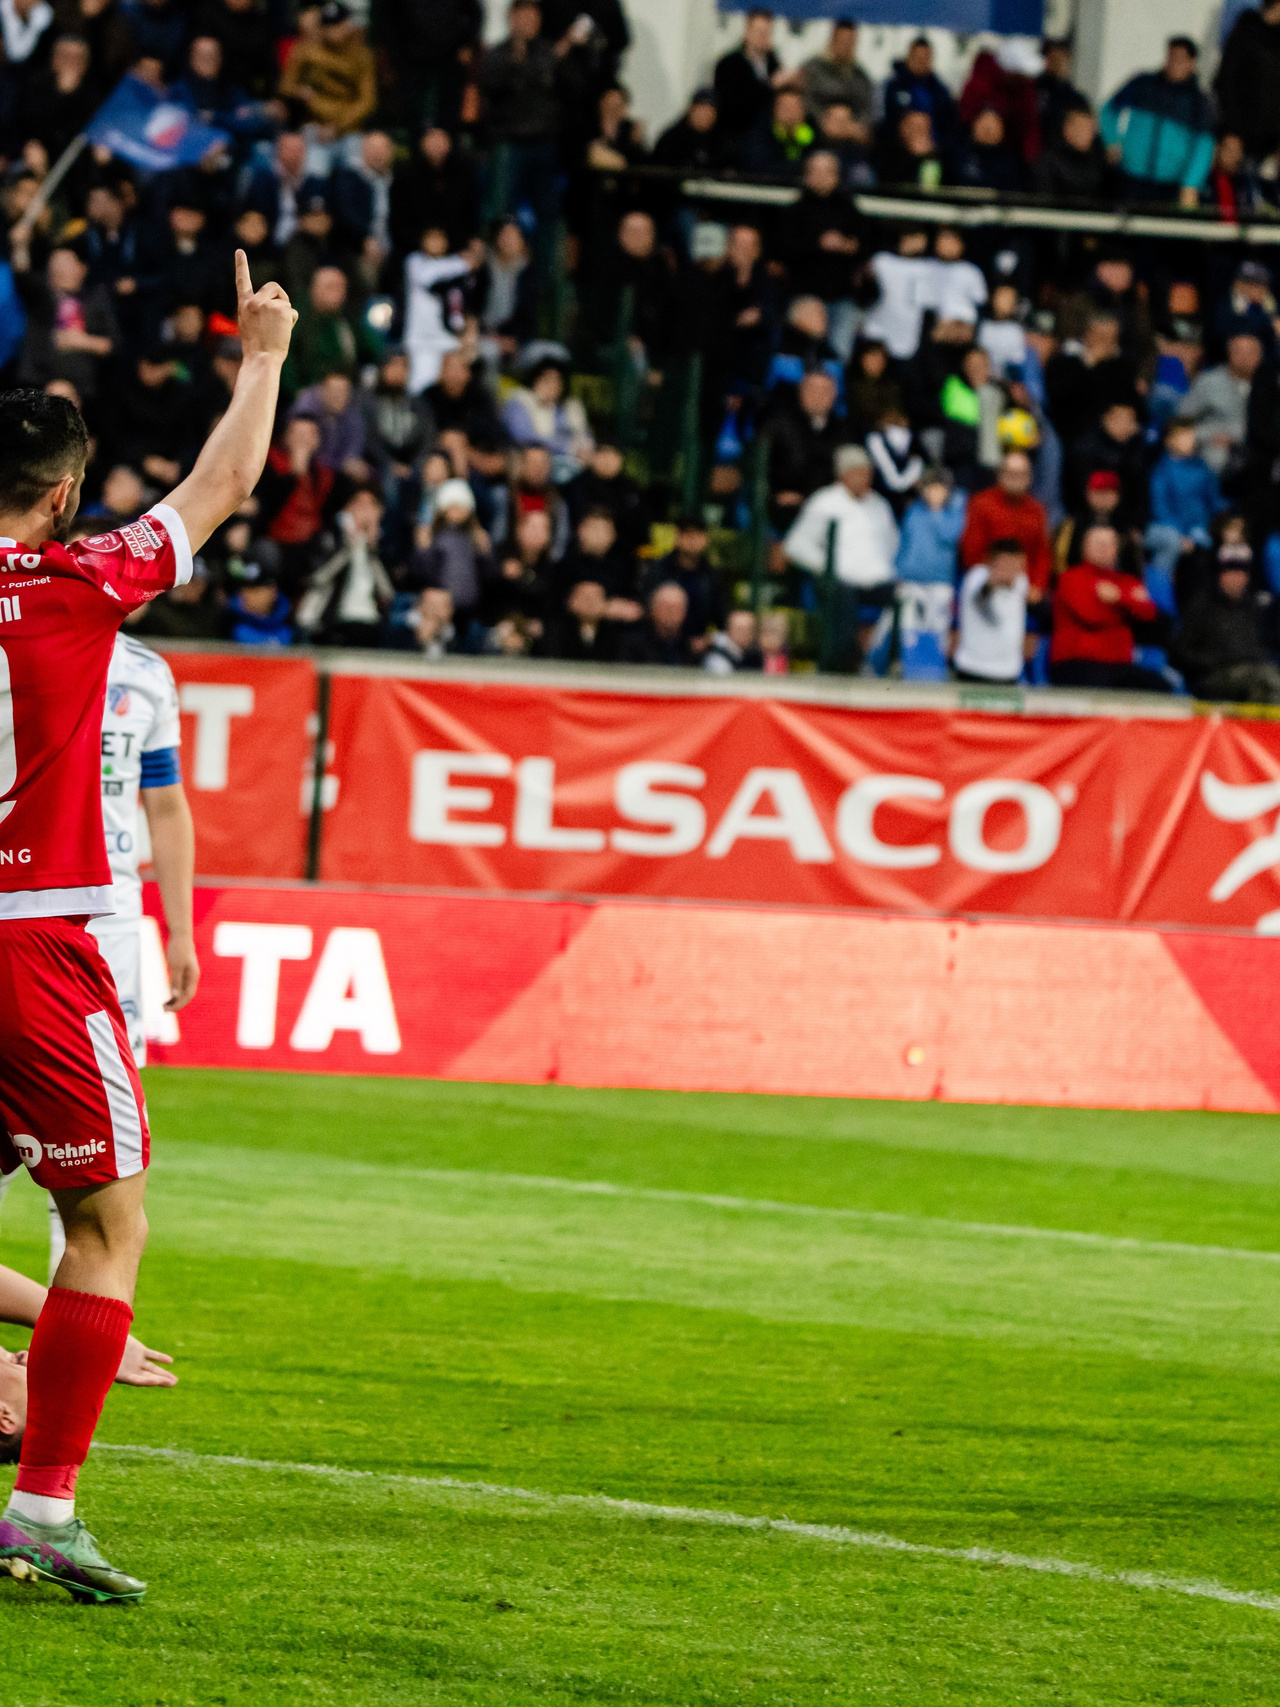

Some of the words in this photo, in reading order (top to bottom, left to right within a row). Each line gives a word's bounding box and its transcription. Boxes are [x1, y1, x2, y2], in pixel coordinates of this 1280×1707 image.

[8, 575, 52, 589] Parchet
[409, 748, 1064, 874] ELSACO
[213, 920, 402, 1055] TA
[42, 1138, 107, 1160] Tehnic
[60, 1157, 95, 1168] GROUP
